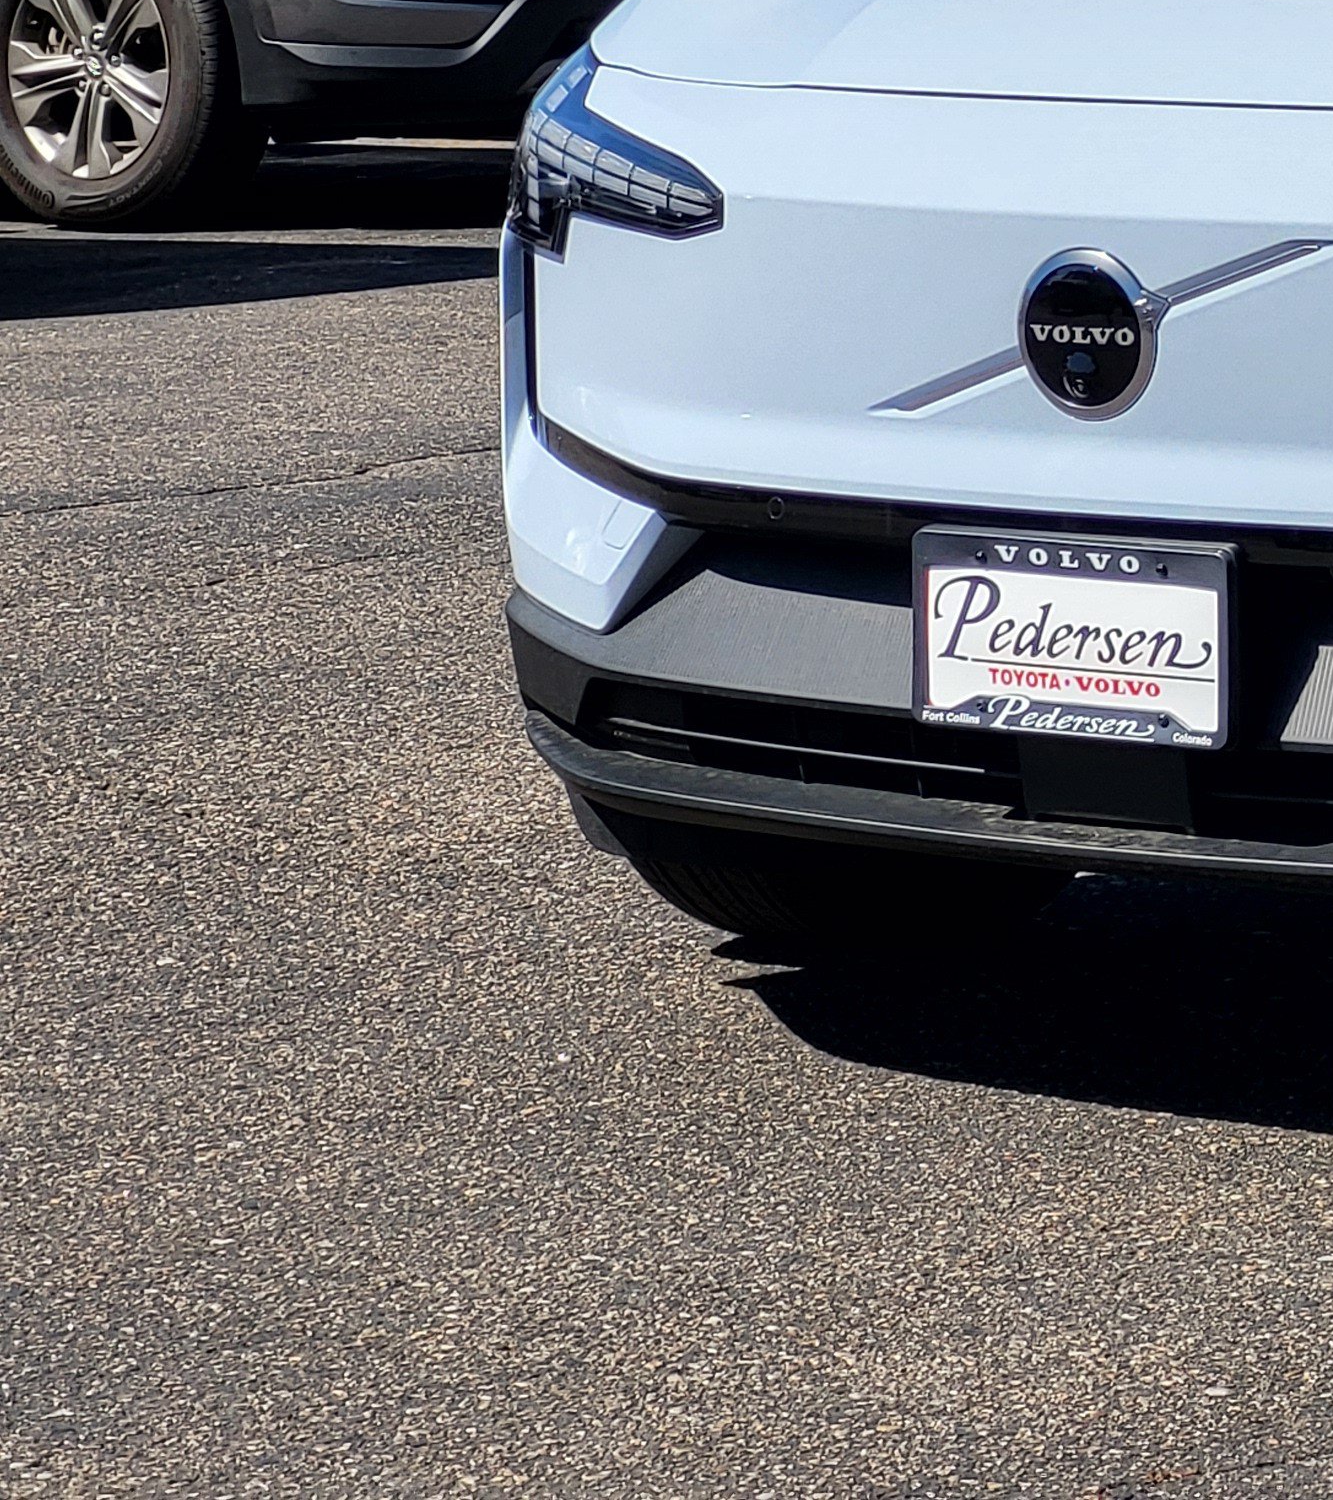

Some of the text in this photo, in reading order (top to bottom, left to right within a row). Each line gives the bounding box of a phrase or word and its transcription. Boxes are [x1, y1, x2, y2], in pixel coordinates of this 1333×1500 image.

[1030, 324, 1135, 346] VOLVO
[994, 544, 1142, 574] VOLVO
[934, 575, 1213, 669] Pedersen
[988, 668, 1161, 697] TOYOTA VOLVO
[922, 710, 980, 724] Fort Collins
[987, 694, 1155, 737] Pedersen
[1172, 732, 1213, 746] Colorado
